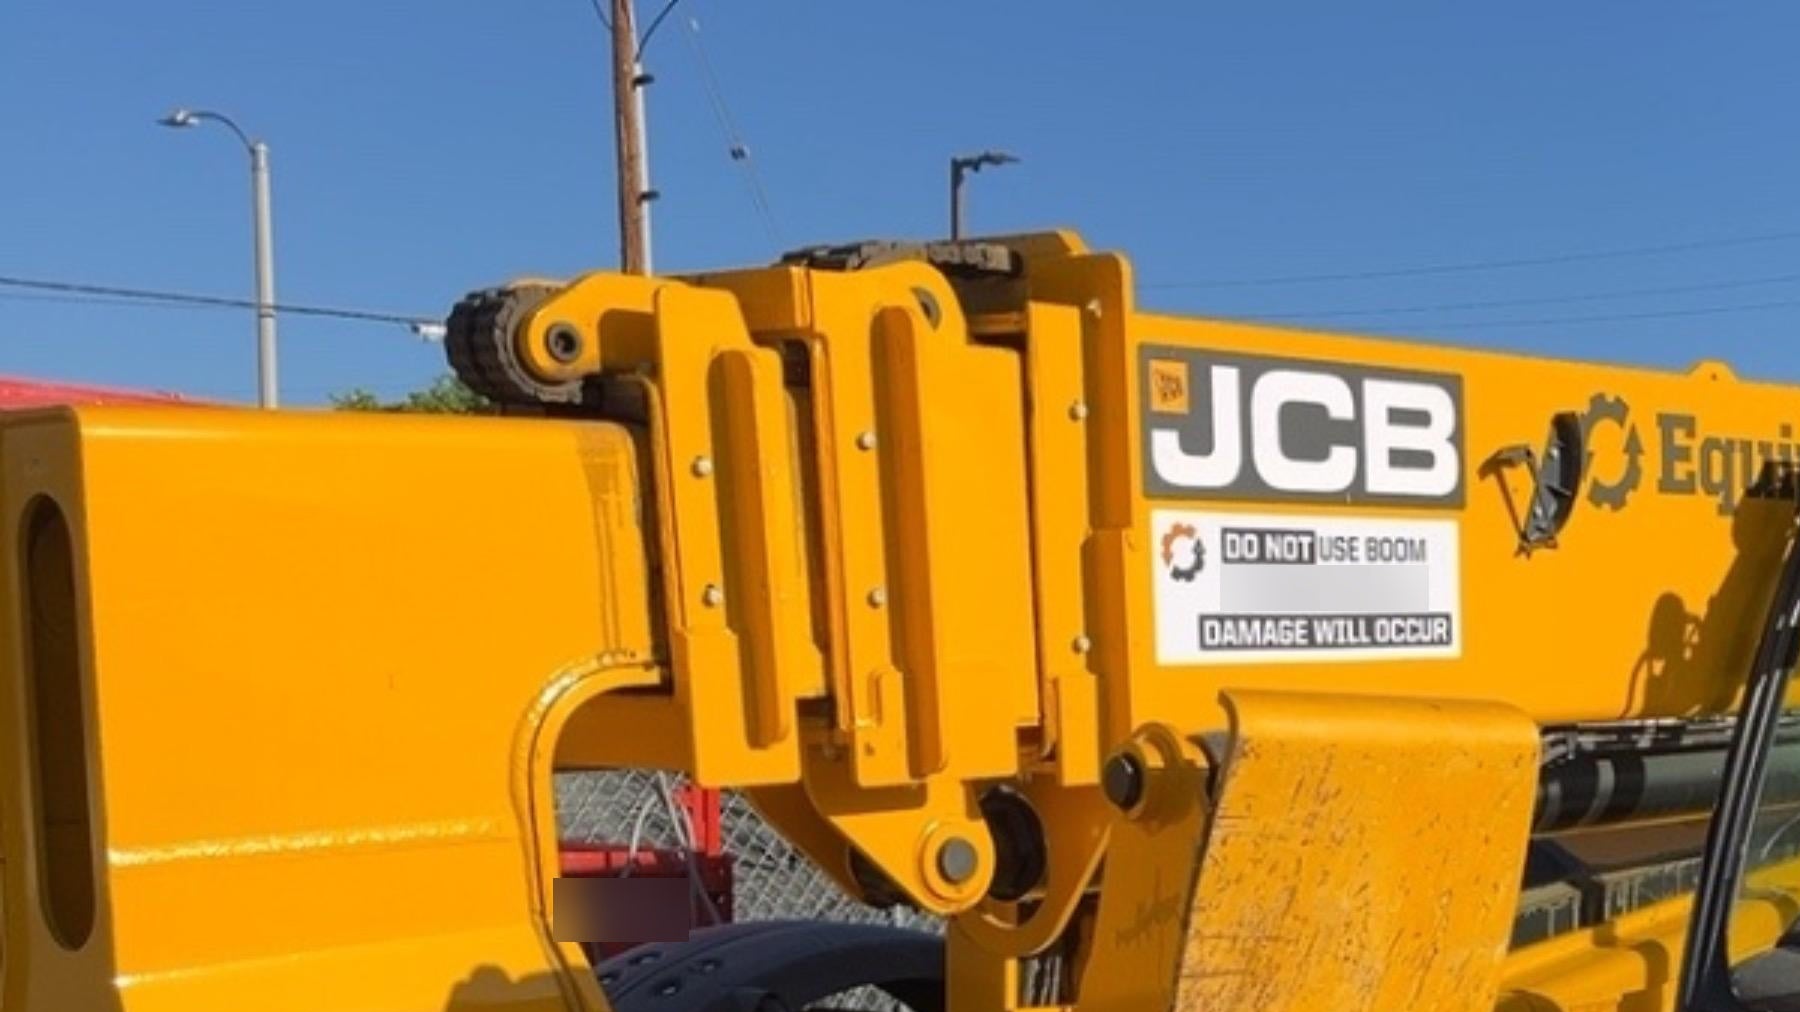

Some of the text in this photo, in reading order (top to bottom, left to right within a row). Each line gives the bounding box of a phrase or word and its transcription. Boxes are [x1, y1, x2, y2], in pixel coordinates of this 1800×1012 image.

[1151, 364, 1458, 498] JCB
[1224, 532, 1428, 563] DO NOT USE BOOM
[1203, 616, 1449, 646] DAMAGE WILL OCCUR
